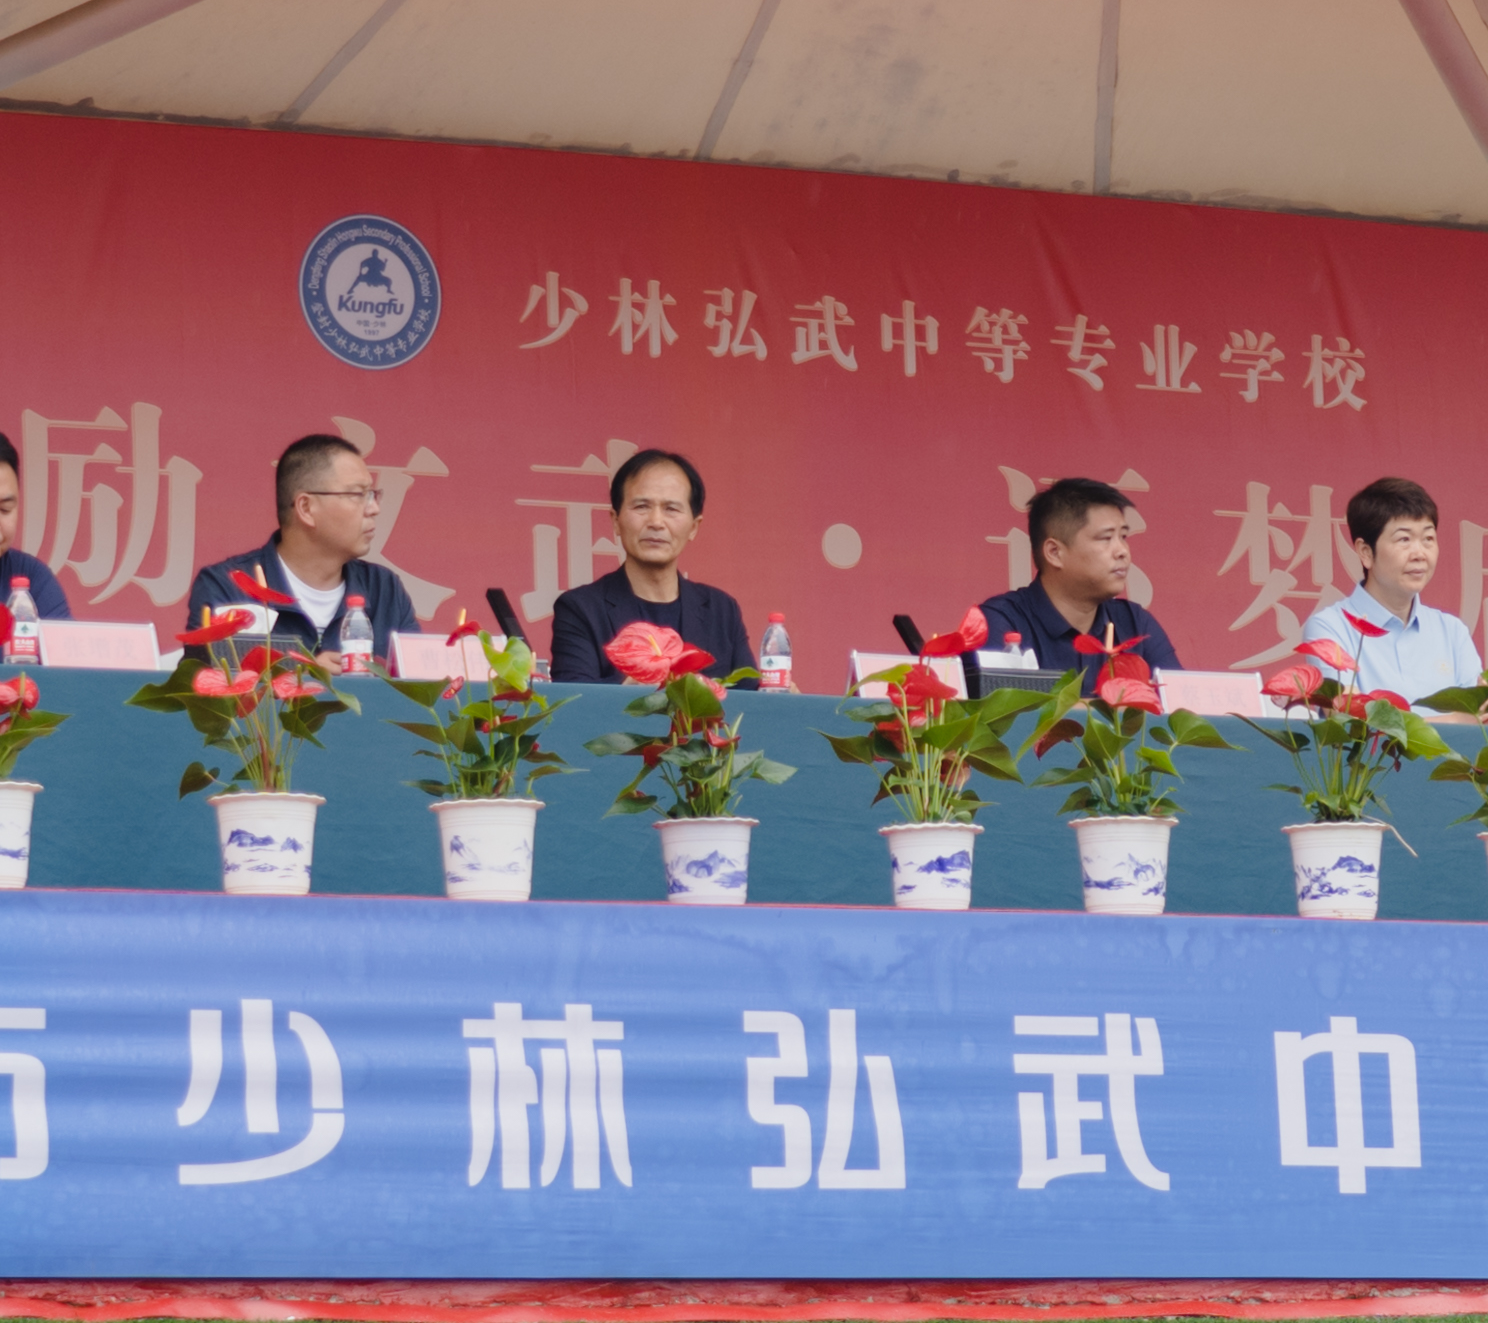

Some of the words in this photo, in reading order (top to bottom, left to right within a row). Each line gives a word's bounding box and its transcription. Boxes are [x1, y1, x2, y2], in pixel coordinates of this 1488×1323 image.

[337, 294, 405, 318] Kungfu
[519, 270, 1369, 412] 少林弘武中等专业学校
